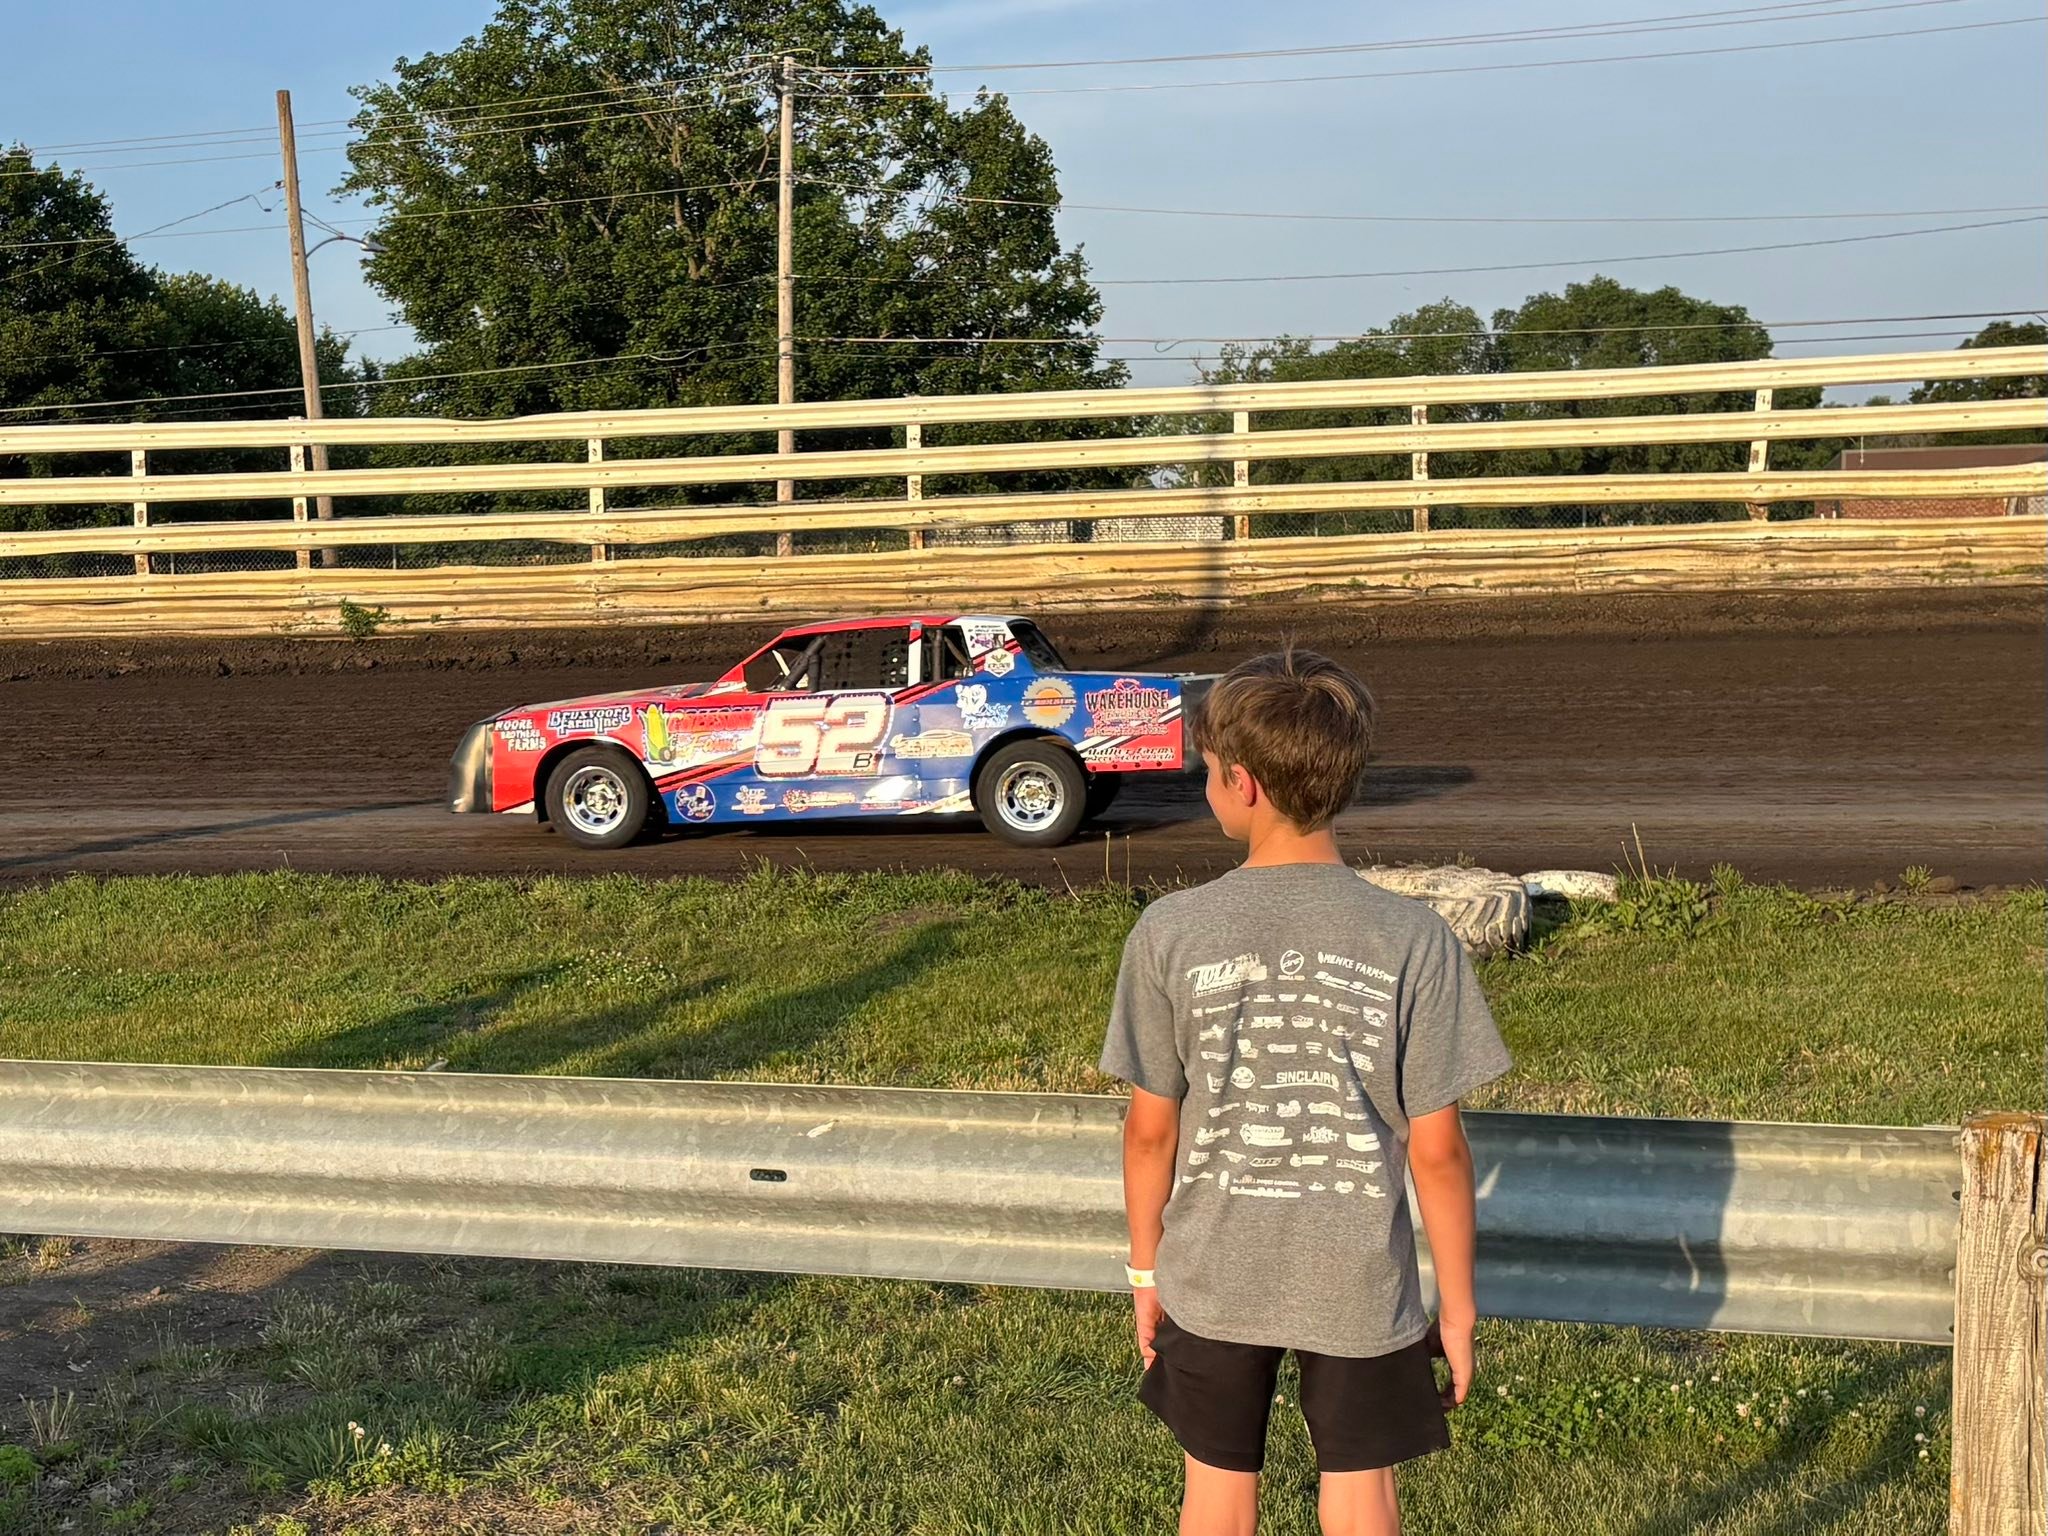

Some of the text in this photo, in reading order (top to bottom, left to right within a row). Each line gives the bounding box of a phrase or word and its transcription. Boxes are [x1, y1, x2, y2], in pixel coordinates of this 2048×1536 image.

[1086, 689, 1168, 710] WAREHOUSE
[495, 719, 532, 731] MOORE
[501, 729, 540, 740] BROTHERS
[755, 692, 893, 779] 52
[508, 738, 547, 752] FARMS
[853, 753, 873, 769] B
[1323, 953, 1355, 969] HENKE
[1355, 962, 1385, 980] FARMS
[1276, 1070, 1331, 1084] SINCLAIR
